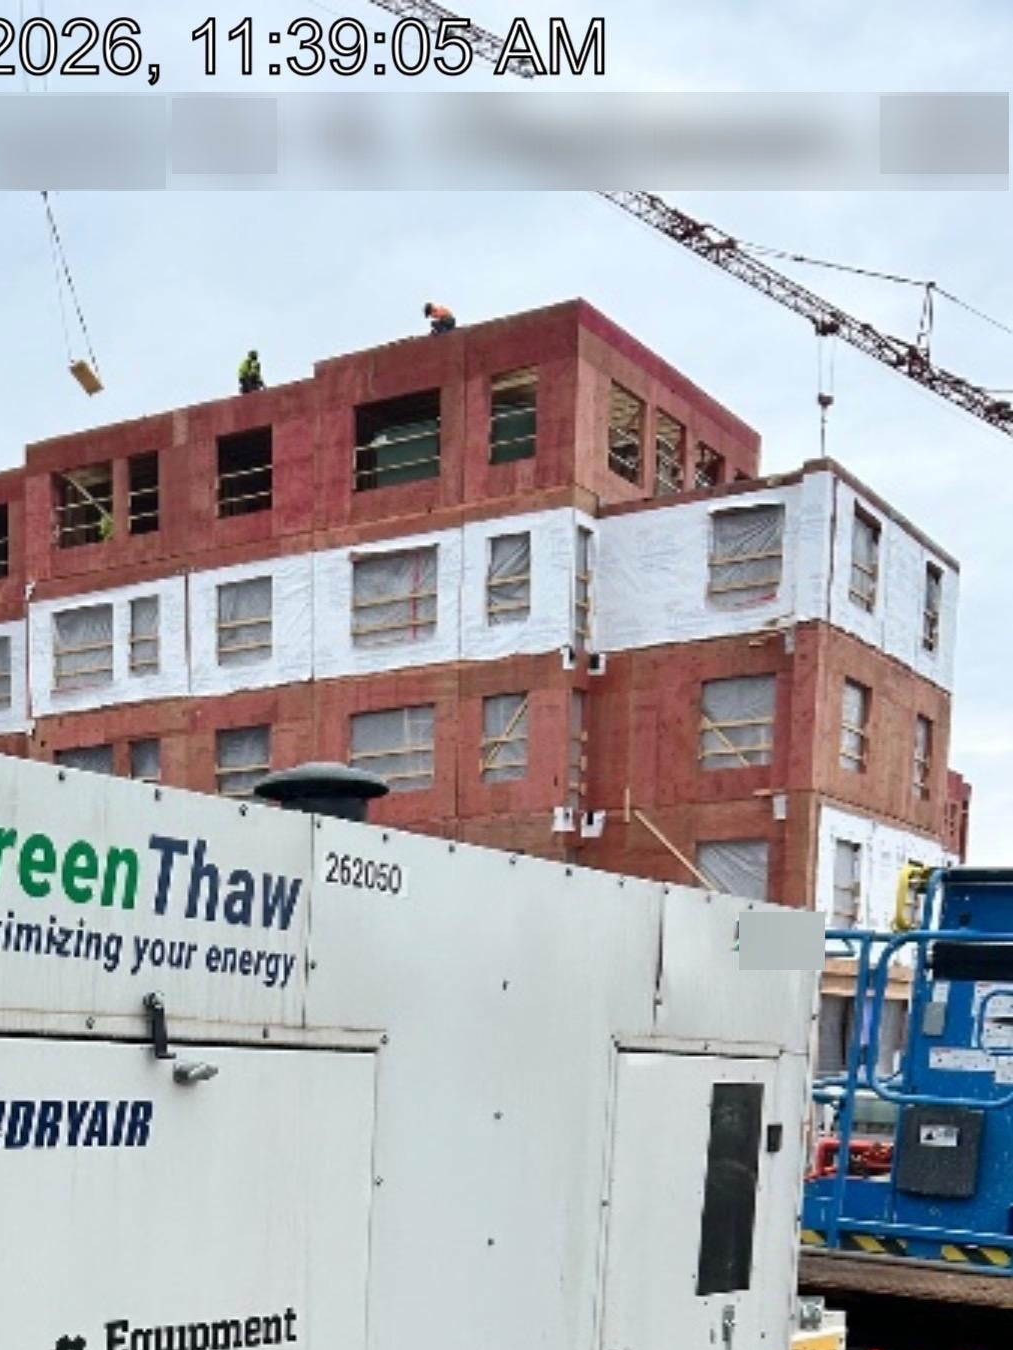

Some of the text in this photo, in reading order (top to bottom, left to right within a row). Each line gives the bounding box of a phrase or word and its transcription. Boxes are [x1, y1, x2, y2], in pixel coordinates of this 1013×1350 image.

[325, 851, 403, 895] 262050
[130, 934, 199, 977] your
[204, 942, 298, 990] energy
[4, 1100, 153, 1148] DRYAIR
